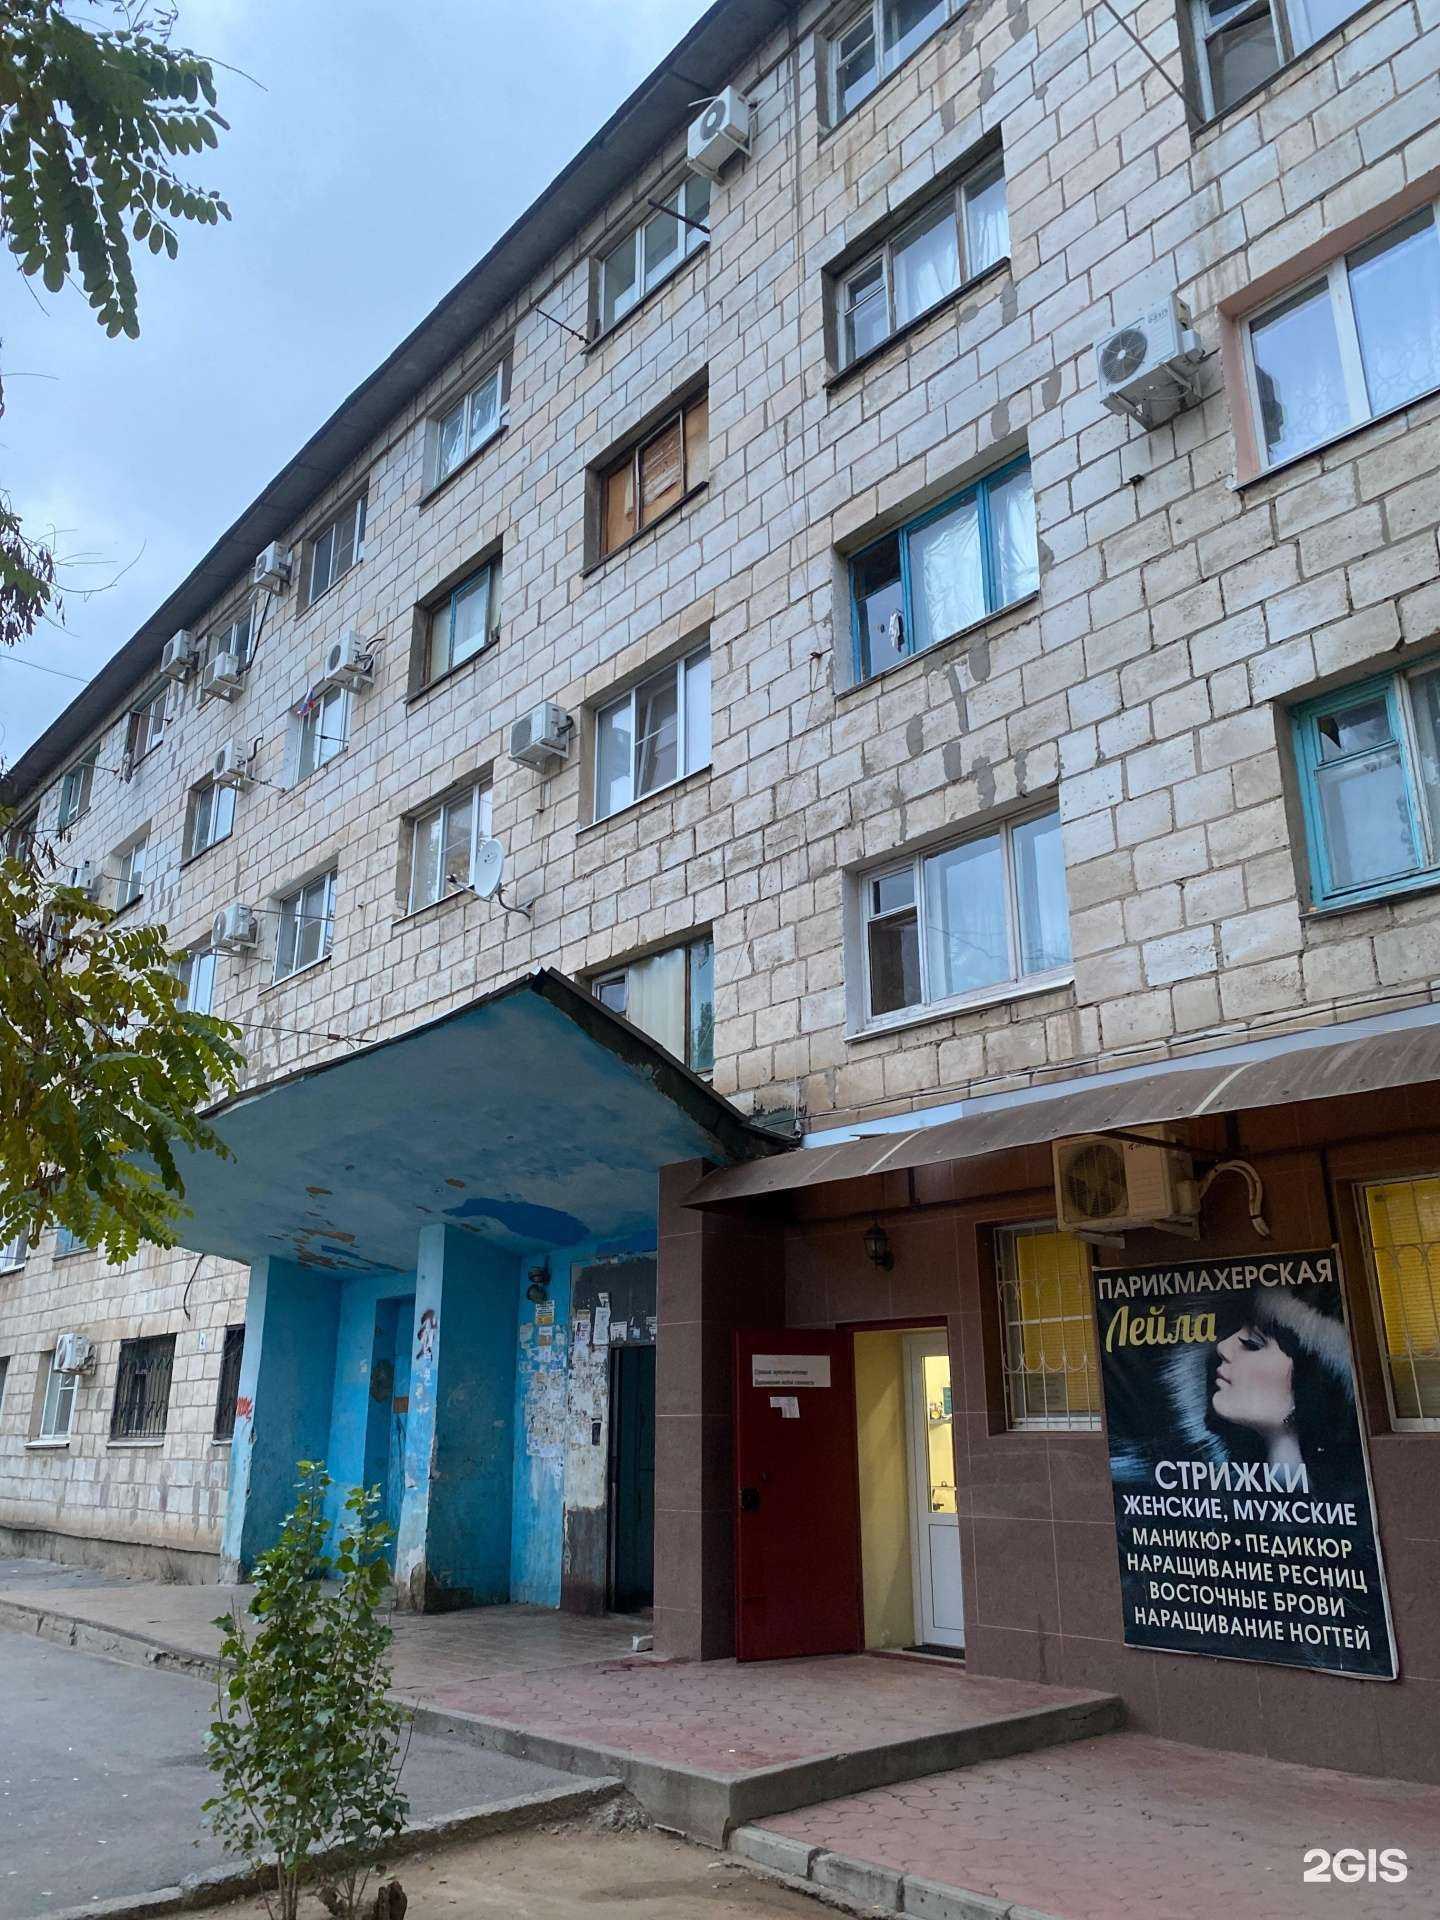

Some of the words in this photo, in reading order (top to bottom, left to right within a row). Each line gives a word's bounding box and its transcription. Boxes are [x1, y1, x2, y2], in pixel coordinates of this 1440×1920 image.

[1098, 1258, 1333, 1300] ПАРИКМАХЕРСКАЯ
[1105, 1304, 1217, 1353] Лейла
[1154, 1460, 1310, 1494] СТРИЖКИ
[1123, 1495, 1228, 1523] ЖЕНСКИЕ,
[1234, 1500, 1358, 1526] МУЖСКИЕ
[1132, 1527, 1231, 1551] МАНИКЮР
[1245, 1533, 1352, 1559] ПЕДИКЮР
[1127, 1553, 1274, 1583] НАРАЩИВАНИЕ
[1280, 1563, 1368, 1594] РЕСНИЦ
[1150, 1581, 1268, 1611] ВОСТОЧНЫЕ
[1274, 1591, 1346, 1618] БРОВИ
[1134, 1606, 1284, 1642] НАРАЩИВАНИЕ
[1290, 1622, 1371, 1651] НОГТЕЙ
